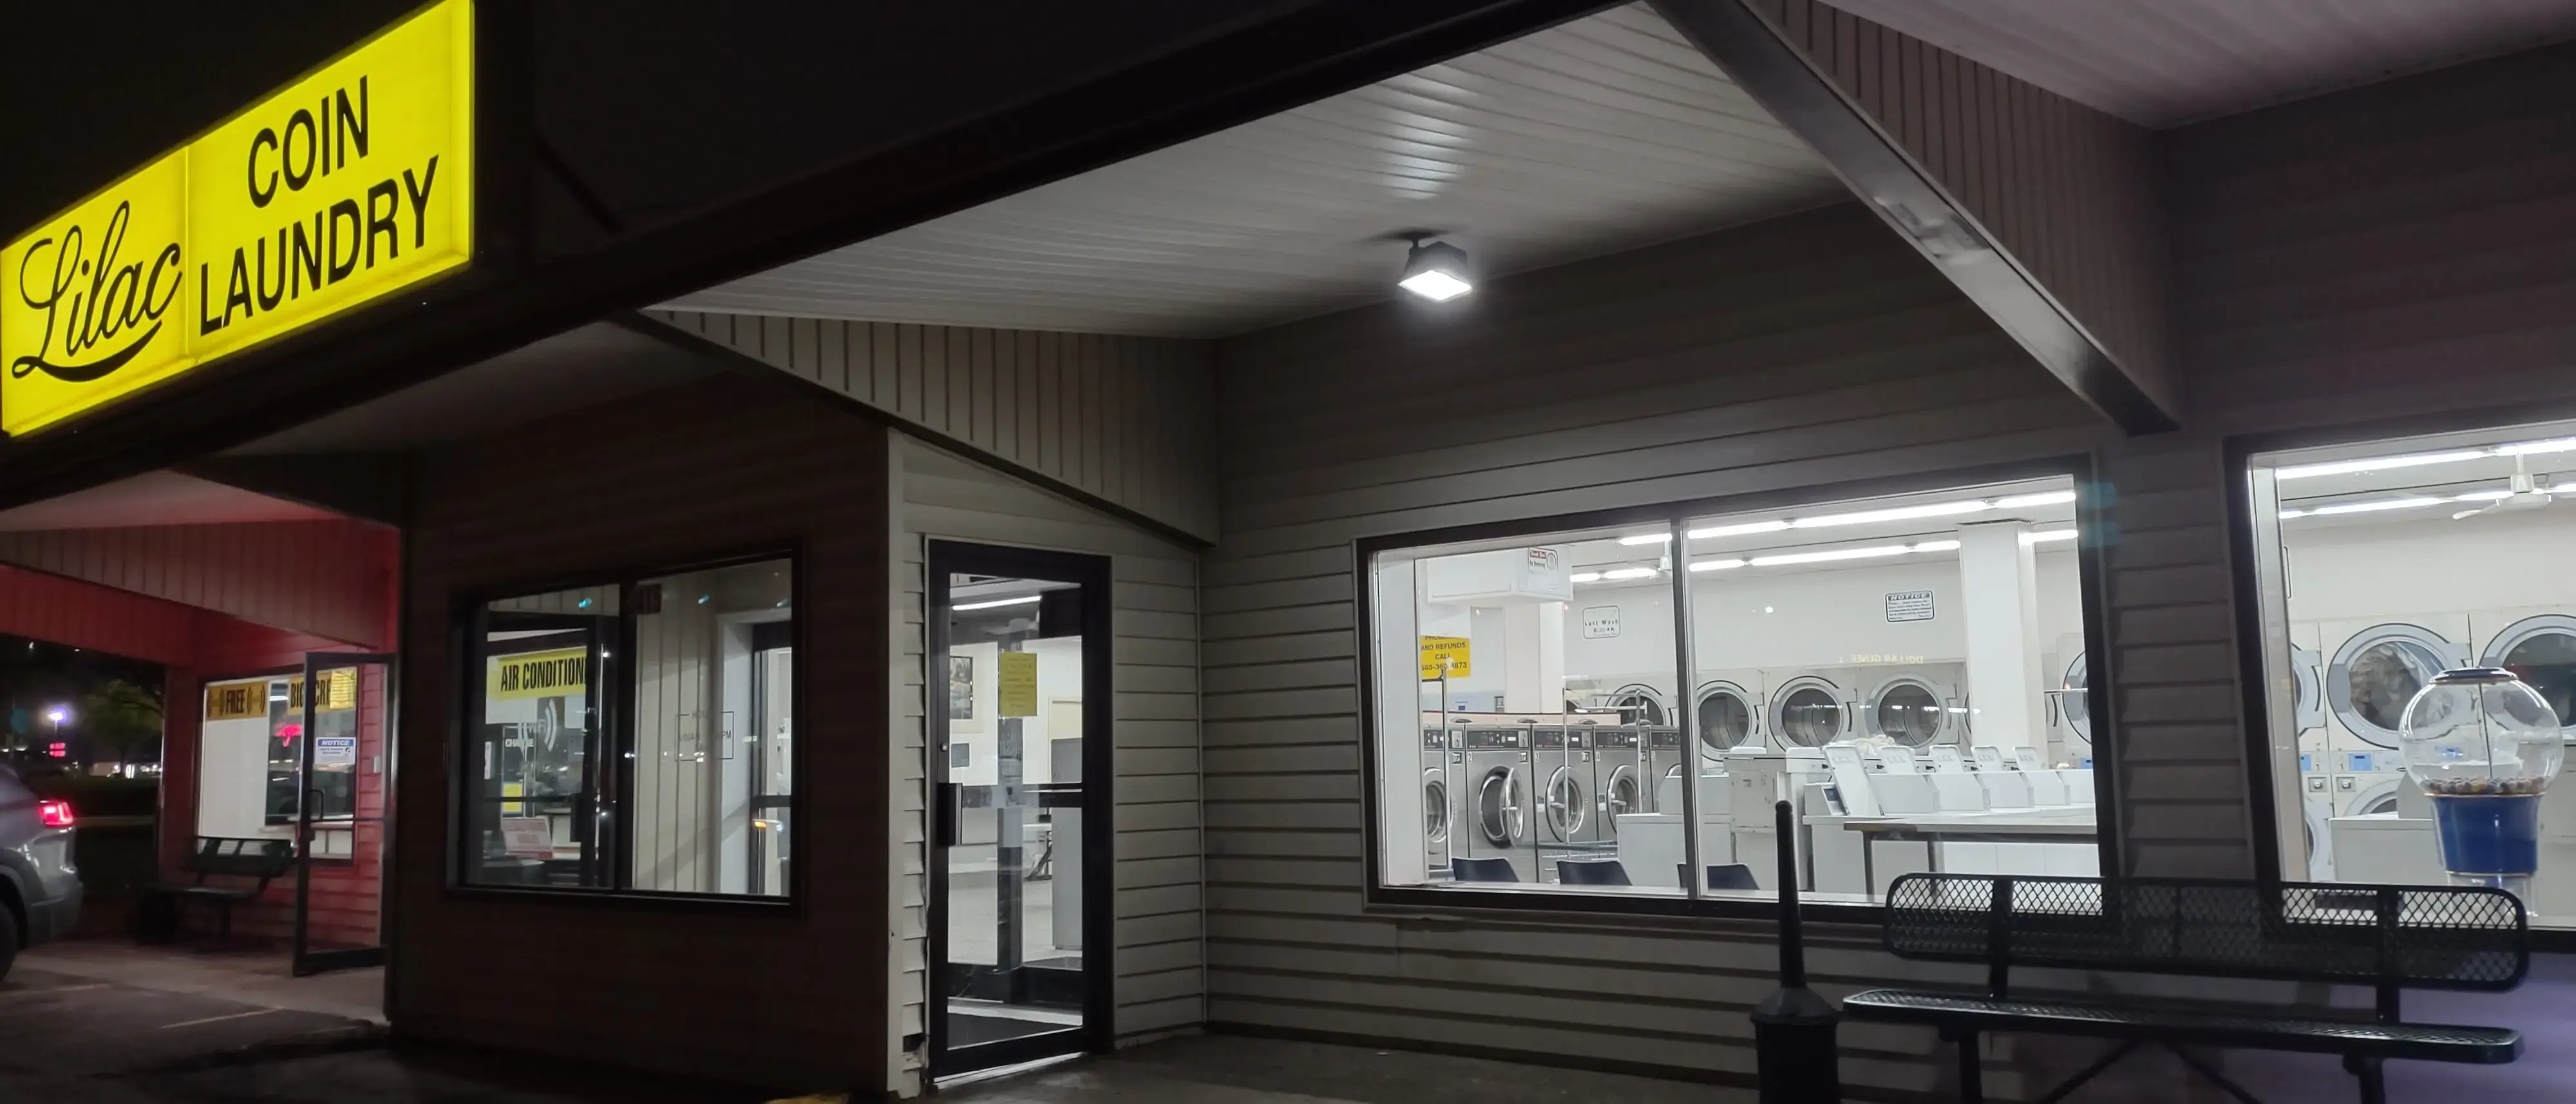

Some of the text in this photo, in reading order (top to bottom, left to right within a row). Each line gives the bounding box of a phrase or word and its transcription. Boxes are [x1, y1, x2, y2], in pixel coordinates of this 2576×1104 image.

[248, 74, 368, 209] COIN
[12, 200, 183, 382] Lilac
[200, 155, 439, 337] LAUNDRY
[500, 656, 585, 692] AIR CONDITION
[1435, 642, 1466, 650] REFUNDS
